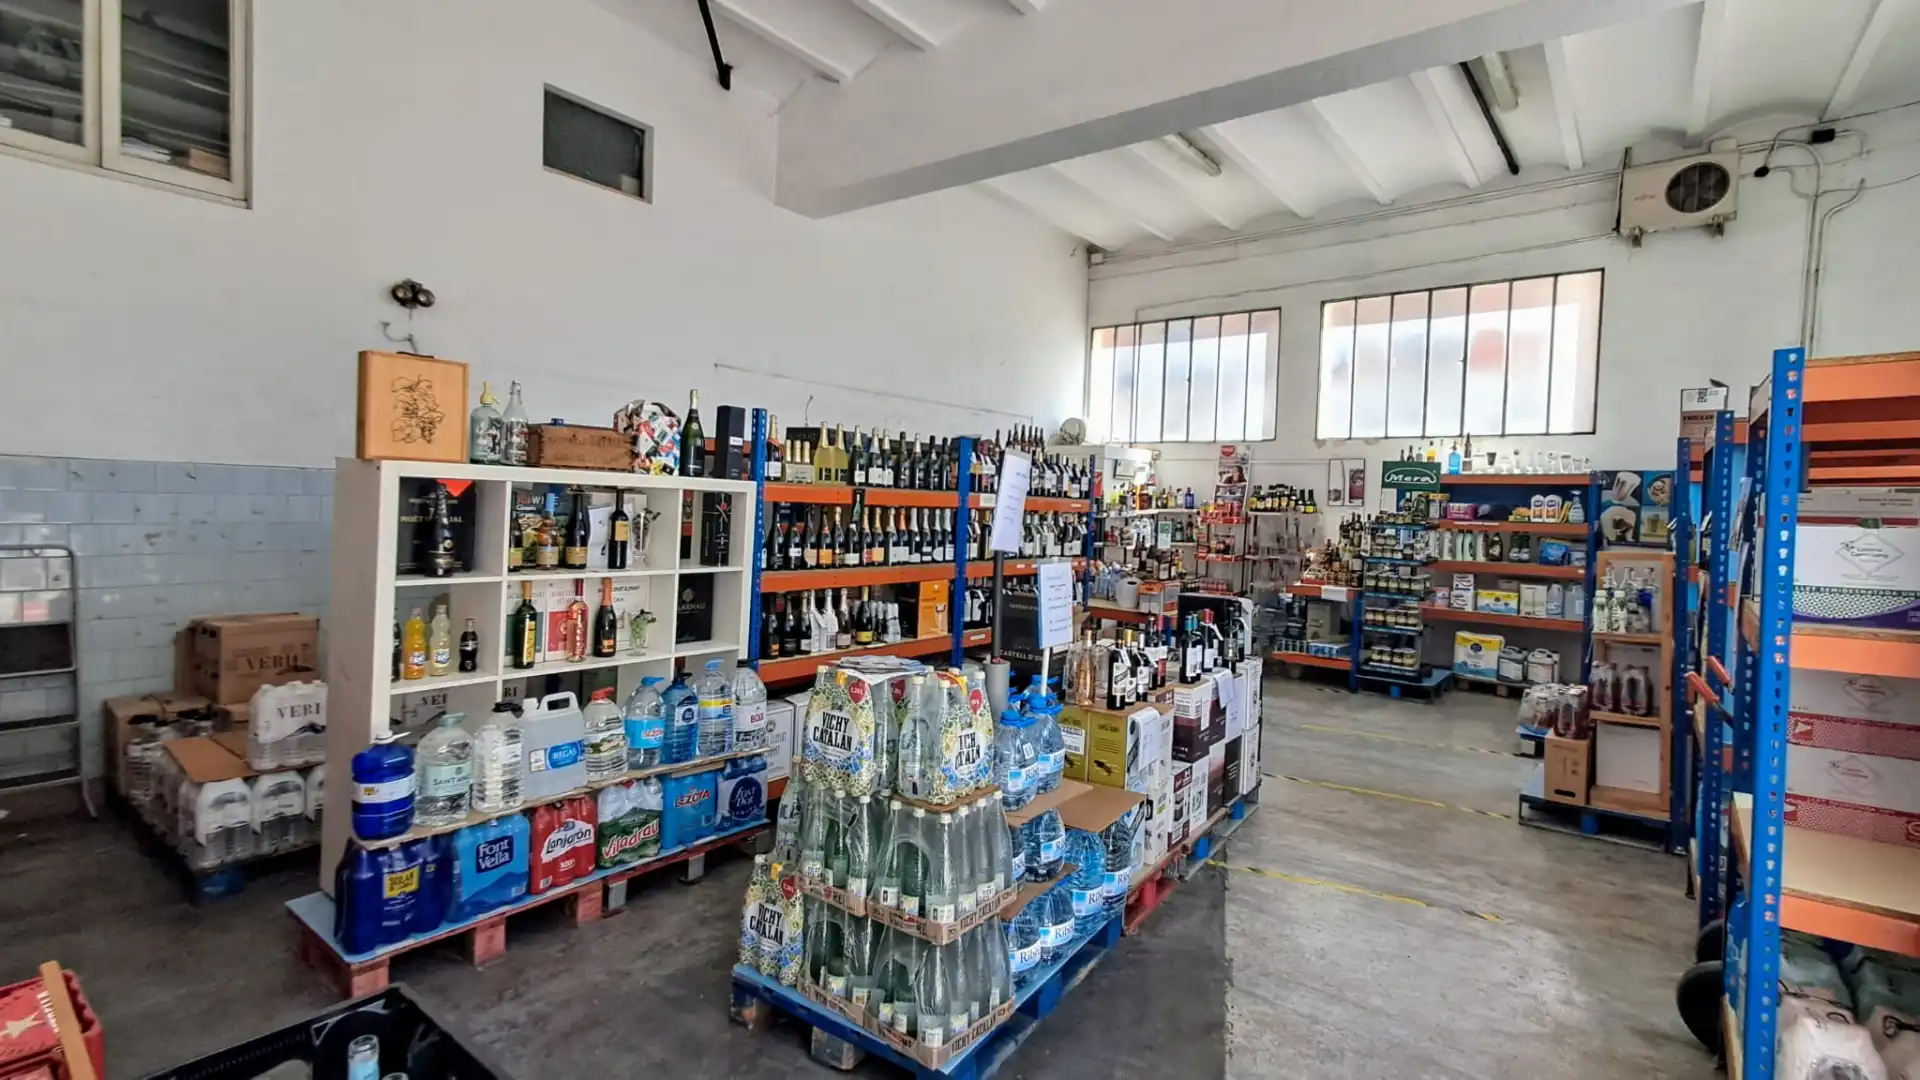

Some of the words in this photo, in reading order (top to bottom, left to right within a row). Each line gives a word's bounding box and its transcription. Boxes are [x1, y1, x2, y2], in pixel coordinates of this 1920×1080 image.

[503, 687, 518, 697] RI
[277, 702, 321, 718] VERI
[822, 711, 850, 733] VICHY
[813, 726, 853, 752] CATALAN
[958, 731, 977, 751] ICH
[675, 788, 711, 808] BEZOYA
[478, 838, 510, 857] Font
[546, 827, 592, 854] Lanjarón
[602, 818, 660, 859] Viladrau
[478, 850, 511, 870] Vella
[951, 1031, 971, 1054] VICHY
[971, 1013, 998, 1045] CATALAN
